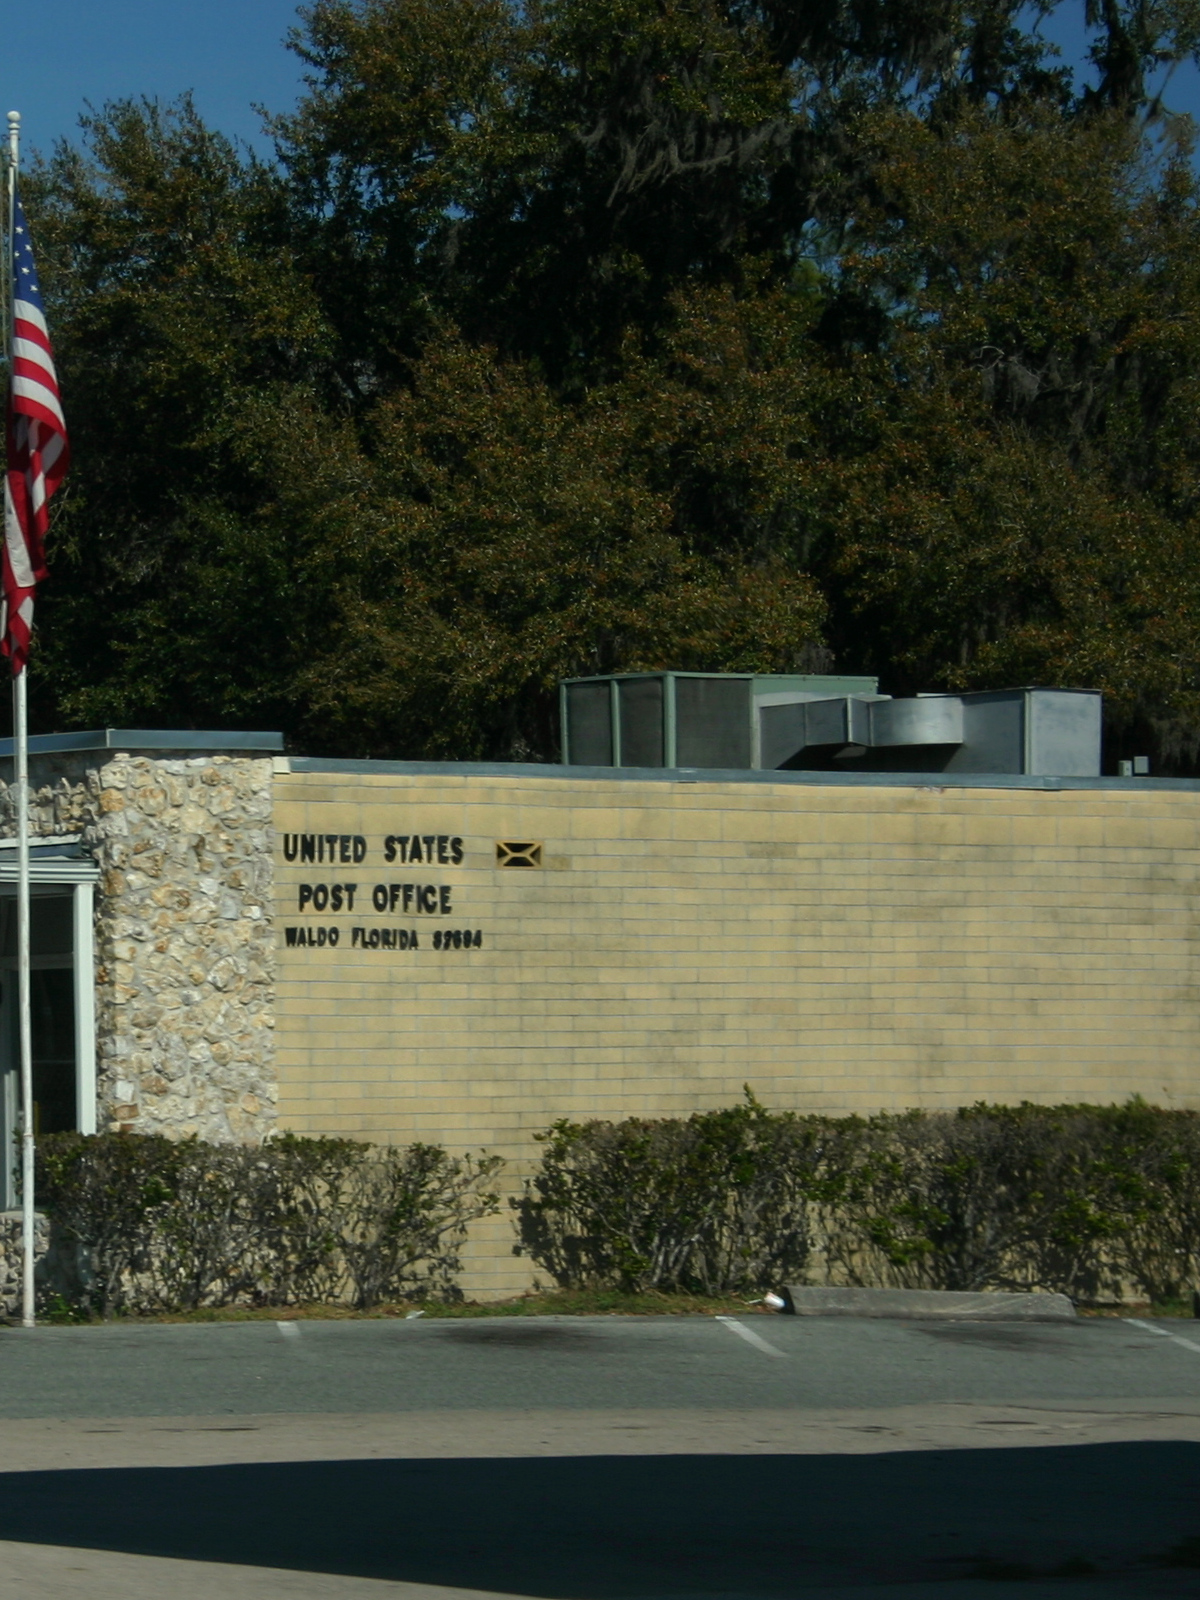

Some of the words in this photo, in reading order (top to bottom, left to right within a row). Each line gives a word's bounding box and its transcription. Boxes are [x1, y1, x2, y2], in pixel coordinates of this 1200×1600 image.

[283, 833, 367, 863] UNITED
[384, 835, 464, 865] STATES
[299, 883, 357, 913] POST
[372, 884, 452, 914] OFFICE
[285, 926, 340, 948] WALDO
[352, 927, 419, 950] FLORIDA
